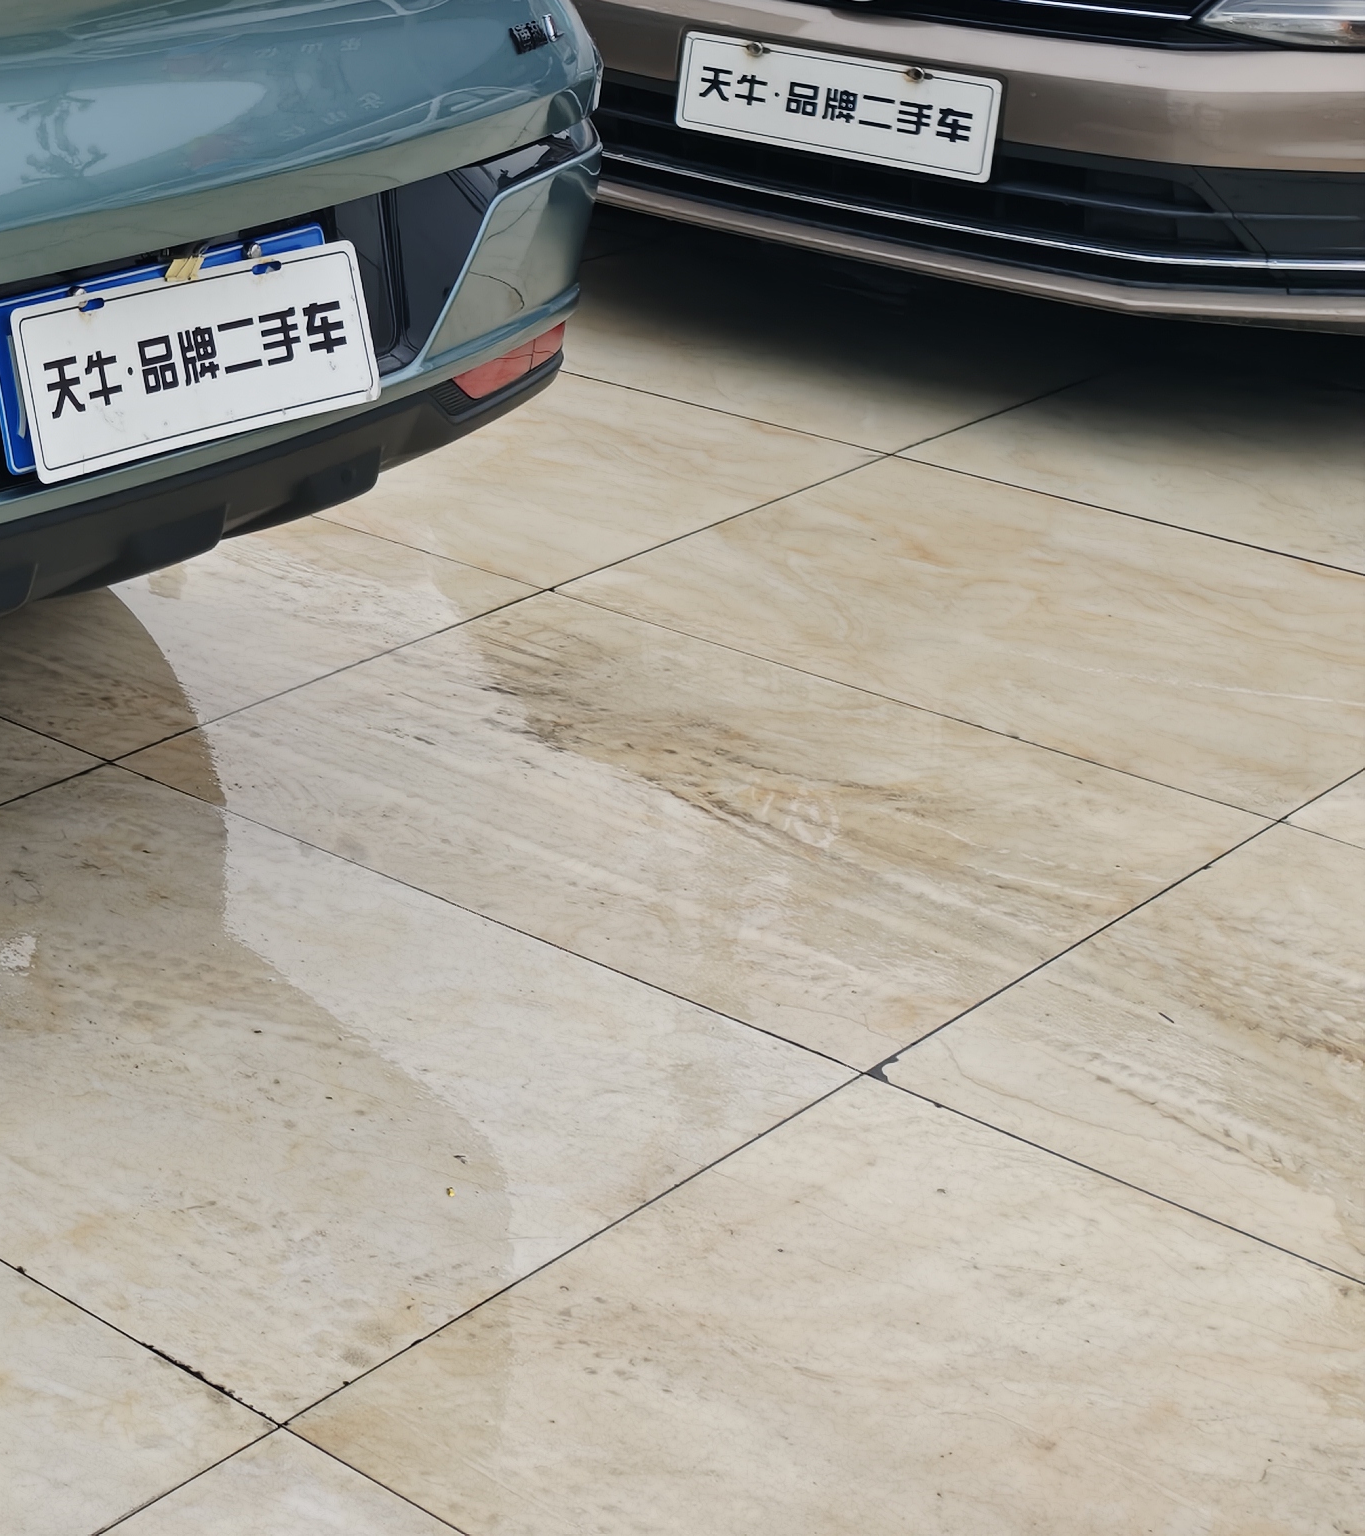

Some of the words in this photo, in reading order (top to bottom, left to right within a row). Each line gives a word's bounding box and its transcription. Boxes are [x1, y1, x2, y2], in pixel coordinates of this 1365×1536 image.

[699, 66, 974, 143] 天牛·品牌二手车
[43, 300, 348, 420] 天牛·品牌二手车
